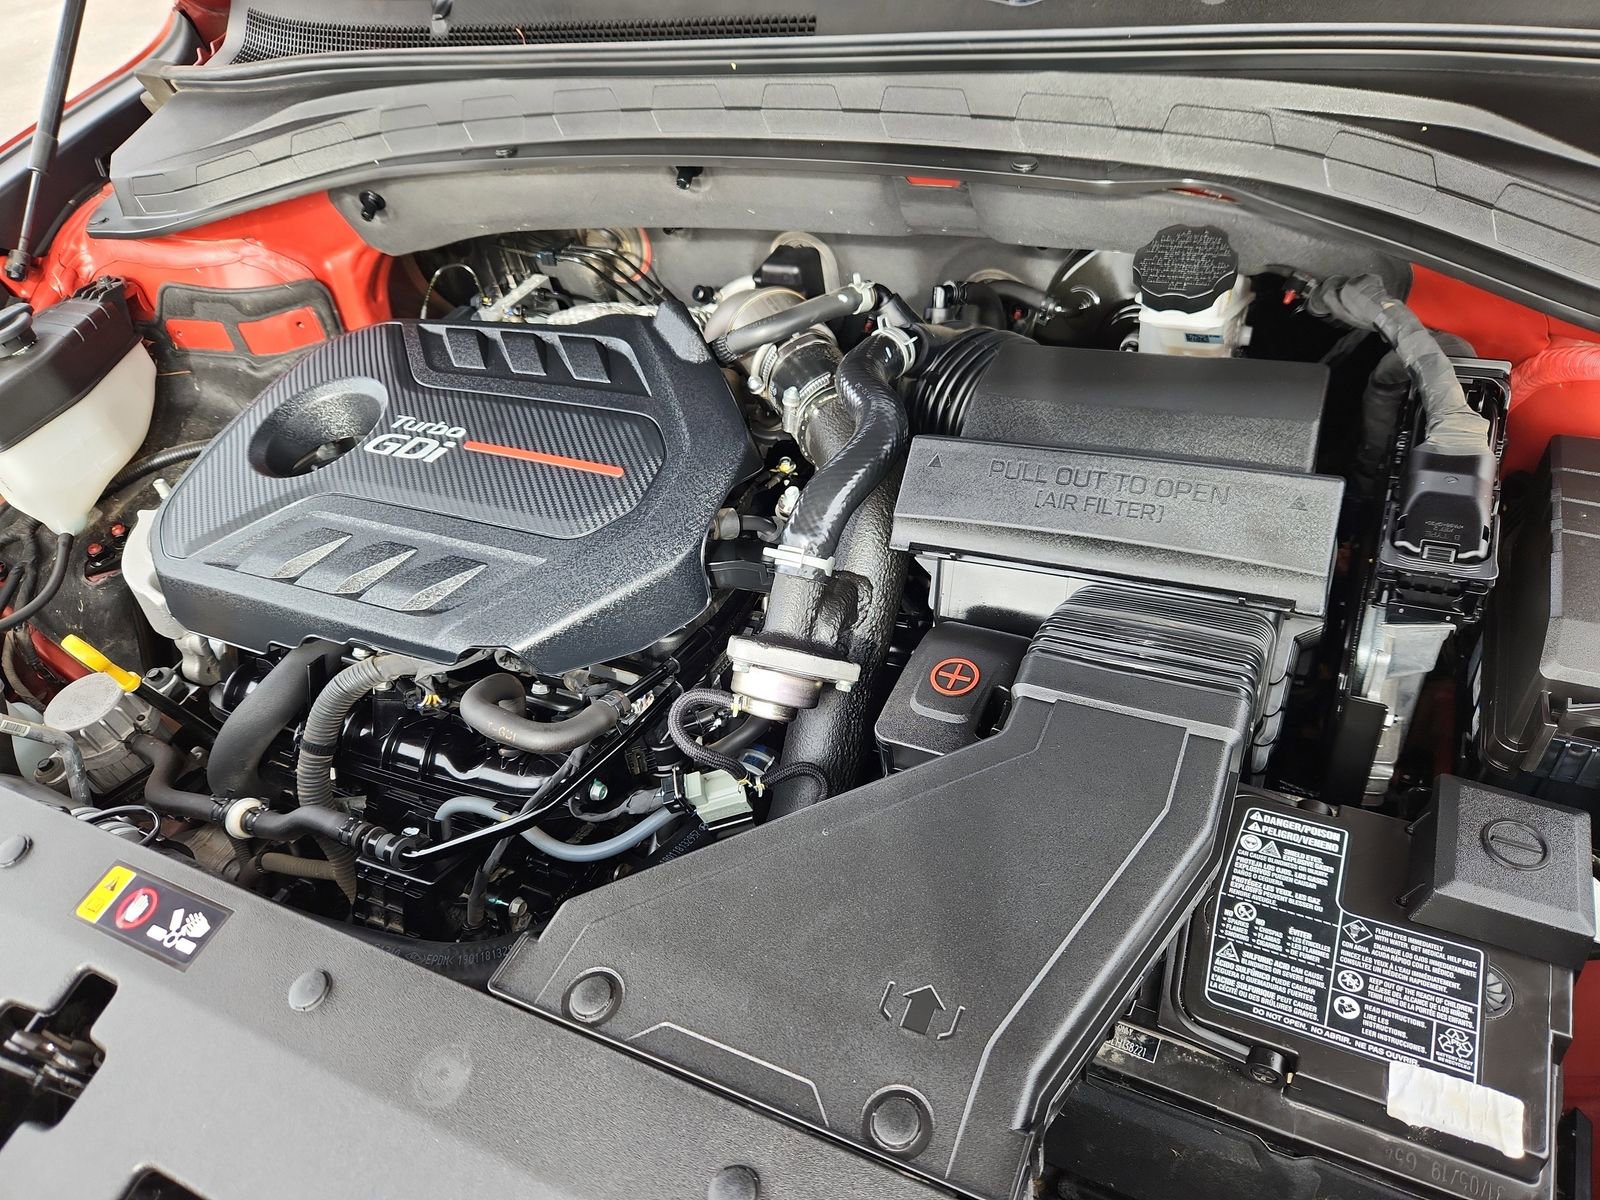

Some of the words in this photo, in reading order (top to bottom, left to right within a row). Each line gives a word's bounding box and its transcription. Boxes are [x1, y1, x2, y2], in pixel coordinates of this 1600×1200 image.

[391, 415, 466, 438] Turbo
[364, 433, 456, 463] GDi
[988, 459, 1048, 484] PULL
[1055, 465, 1109, 488] OUT
[1113, 474, 1148, 494] TO
[1156, 479, 1230, 505] OPEN
[1261, 825, 1339, 853] PELIGRO/VENENO
[1263, 815, 1340, 842] DANGER/POISON
[1238, 849, 1249, 857] CAN
[1250, 852, 1267, 861] CAUSE
[1282, 855, 1314, 868] EXPLOSIVE
[1315, 863, 1334, 873] GASES
[1234, 862, 1271, 877] EXPLOSIVOS
[1236, 856, 1263, 868] PROTEJA
[1263, 863, 1275, 872] LOS
[1295, 872, 1307, 880] LOS
[1307, 875, 1328, 886] GASES
[1230, 881, 1262, 895] EXPLOSIFS
[1288, 897, 1313, 909] BLESSER
[1314, 904, 1323, 912] OU
[1263, 884, 1275, 892] LES
[1295, 893, 1307, 901] LES
[1224, 909, 1234, 917] NO
[1255, 918, 1266, 926] NO
[1226, 924, 1248, 935] FLAMES
[1289, 926, 1313, 940] ÉVITER
[1376, 927, 1393, 937] FLUSH
[1394, 933, 1407, 942] EYES
[1408, 937, 1444, 953] IMMEDIATELY
[1291, 943, 1302, 951] LES
[1299, 952, 1320, 963] FUMER
[1341, 949, 1361, 960] RINCEZ
[1362, 955, 1372, 963] LES
[1374, 959, 1388, 968] YEUX
[1342, 940, 1353, 948] CON
[1372, 949, 1390, 960] ACUDA
[1412, 961, 1424, 970] CON
[1375, 934, 1392, 944] WITH
[1411, 945, 1421, 953] GET
[1422, 948, 1446, 960] MEDICAL
[1447, 955, 1462, 964] HELP
[1402, 951, 1413, 959] LOS
[1414, 955, 1428, 964] OJOS
[1241, 958, 1272, 972] BLINDNESS
[1282, 970, 1304, 982] SEVERE
[1242, 951, 1273, 966] SULFURIC
[1274, 961, 1290, 971] ACID
[1291, 966, 1303, 975] CAN
[1304, 970, 1324, 981] CAUSE
[1340, 955, 1372, 970] CONSULTEZ
[1213, 966, 1240, 979] CEGUERA
[1246, 976, 1286, 993] QUEMADURAS
[1287, 988, 1316, 1002] FUERTES.
[1271, 976, 1291, 988] PUEDE
[1291, 982, 1316, 995] CAUSAR
[1370, 977, 1383, 986] KEEP
[1384, 982, 1395, 990] OUT
[1405, 988, 1415, 996] THE
[1416, 991, 1434, 1002] REACH
[1209, 981, 1218, 989] LA
[1239, 990, 1247, 998] OU
[1248, 993, 1260, 1002] DES
[1293, 1008, 1319, 1021] GRAVES.
[1236, 982, 1276, 1000] SULFURIQUE
[1277, 995, 1292, 1005] PEUT
[1293, 1000, 1317, 1013] CAUSER
[1365, 1004, 1380, 1014] READ
[1368, 991, 1382, 1001] TENIR
[1408, 1003, 1414, 1011] LA
[1437, 1013, 1447, 1021] DES
[1392, 991, 1402, 999] DEL
[1404, 995, 1428, 1007] ALCANCE
[1438, 1005, 1449, 1014] LOS
[1364, 1013, 1377, 1022] LIRE
[1378, 1017, 1389, 1025] LES
[1252, 1007, 1264, 1016] DO
[1265, 1011, 1282, 1021] NOT
[1283, 1015, 1307, 1030] OPEN.
[1311, 1023, 1323, 1036] NO
[1324, 1031, 1351, 1045] ABRIR.
[1355, 1040, 1366, 1049] NE
[1368, 1044, 1384, 1056] PAS
[1362, 1028, 1376, 1038] LEER
